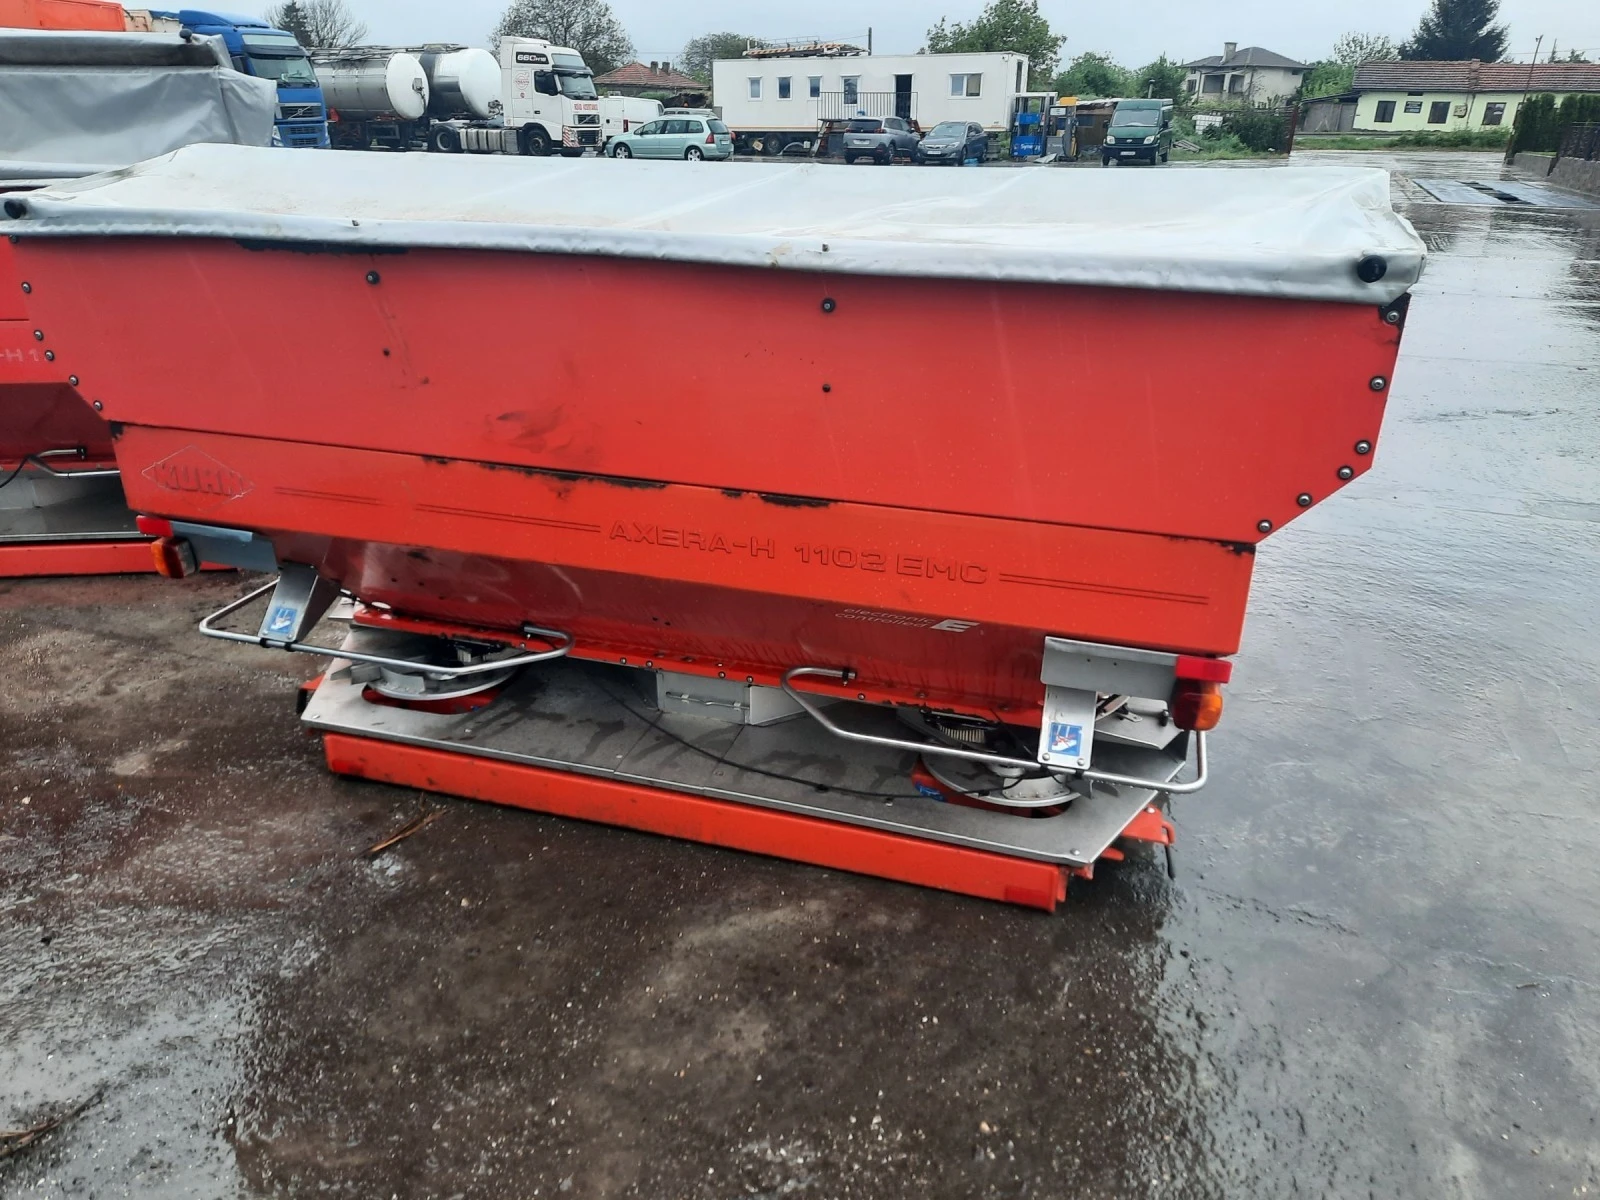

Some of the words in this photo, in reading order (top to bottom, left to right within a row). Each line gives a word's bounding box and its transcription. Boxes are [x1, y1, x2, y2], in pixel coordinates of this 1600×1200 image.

[609, 519, 775, 559] AXERA-H
[794, 542, 886, 572] 1102
[896, 553, 988, 584] EMC
[834, 612, 928, 628] controlled
[843, 607, 936, 624] electronic
